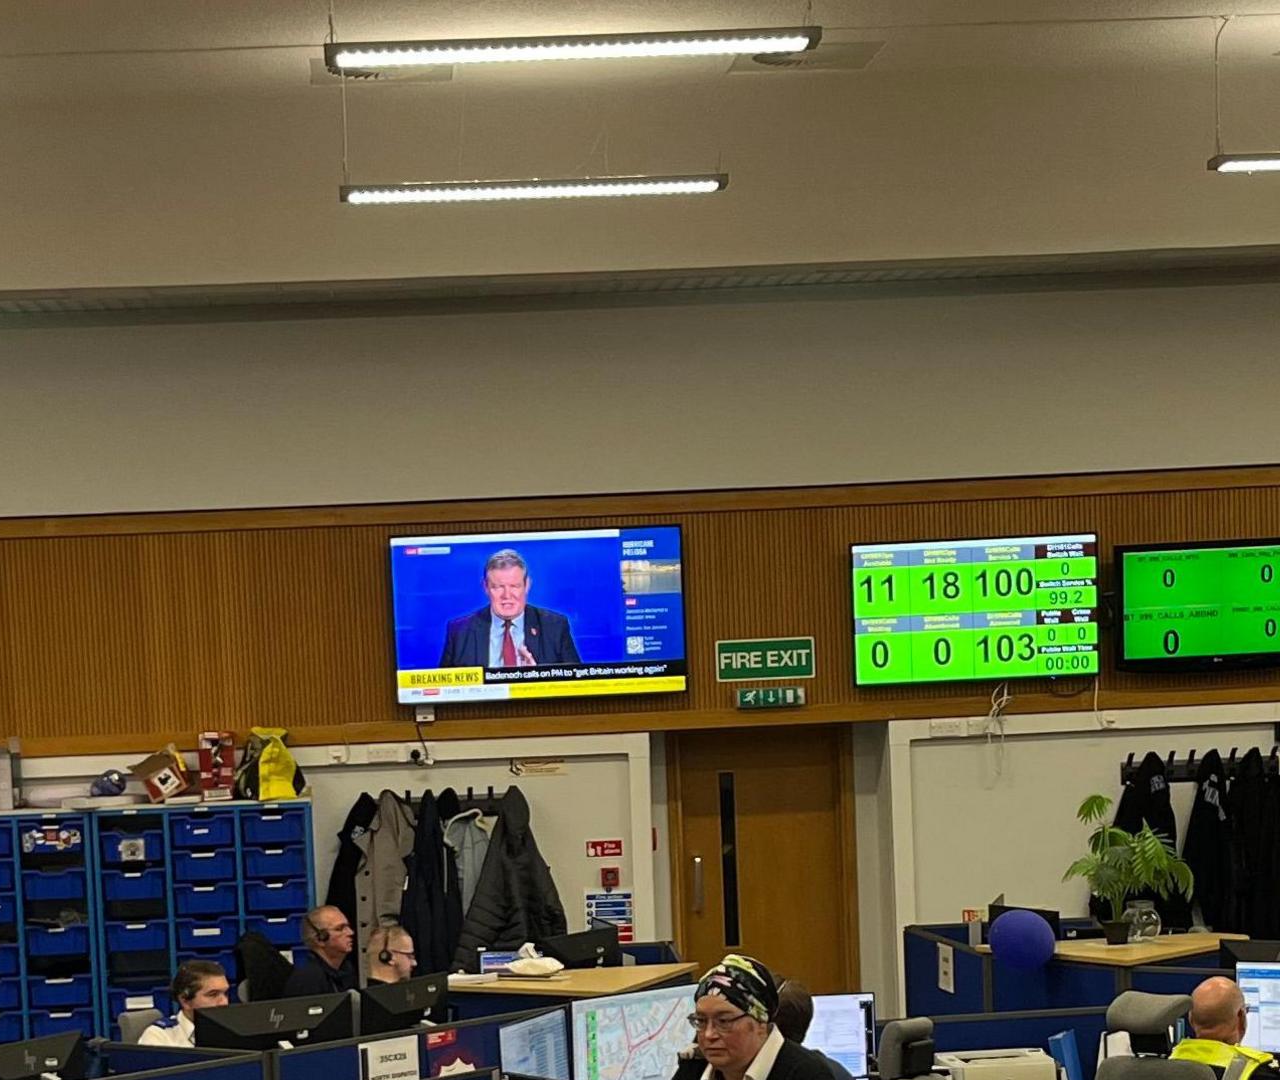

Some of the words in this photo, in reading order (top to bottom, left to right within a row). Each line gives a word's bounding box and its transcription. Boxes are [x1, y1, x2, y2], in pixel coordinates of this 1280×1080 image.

[1061, 562, 1070, 576] 0
[1163, 569, 1175, 587] 0
[1261, 565, 1273, 583] 0
[860, 575, 894, 603] 11
[922, 572, 960, 600] 18
[975, 568, 1033, 597] 100
[1049, 590, 1083, 605] 99.2
[1047, 628, 1056, 642] 0
[1078, 627, 1086, 640] 0
[1265, 619, 1277, 638] 0
[976, 633, 1036, 663] 103
[1163, 630, 1180, 655] 0
[719, 651, 762, 670] FIRE
[766, 649, 810, 668] EXIT
[871, 640, 889, 669] 0
[934, 638, 951, 666] 0
[1045, 655, 1090, 671] 00:00
[410, 673, 451, 685] BREAKING
[455, 672, 480, 683] NEWS
[485, 670, 522, 681] Badenoch
[523, 669, 539, 679] calls
[551, 669, 563, 677] PM
[564, 669, 573, 677] to
[589, 667, 614, 676] Britain
[614, 666, 644, 676] working
